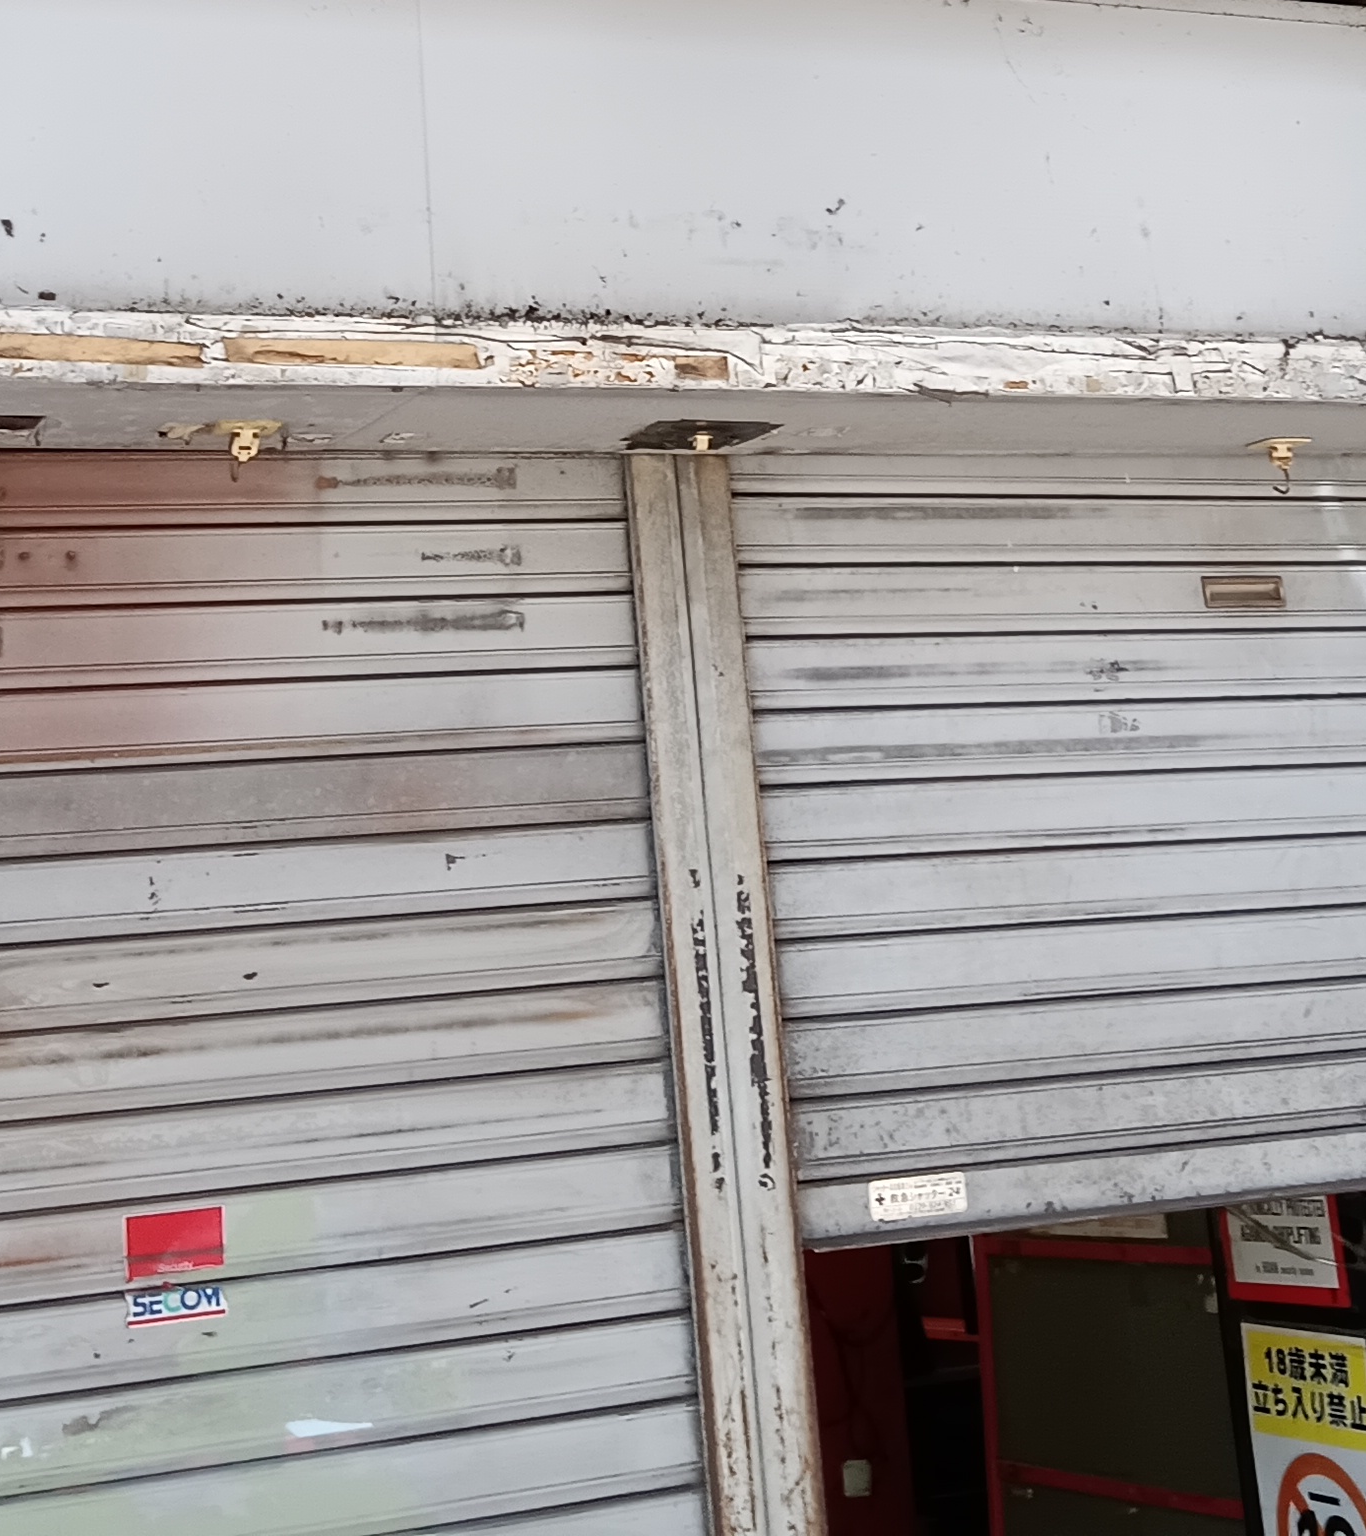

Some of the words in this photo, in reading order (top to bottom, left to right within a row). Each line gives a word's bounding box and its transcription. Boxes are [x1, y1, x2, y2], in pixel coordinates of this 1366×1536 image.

[132, 1287, 221, 1317] SECOM
[1264, 1346, 1350, 1389] 18歳未満
